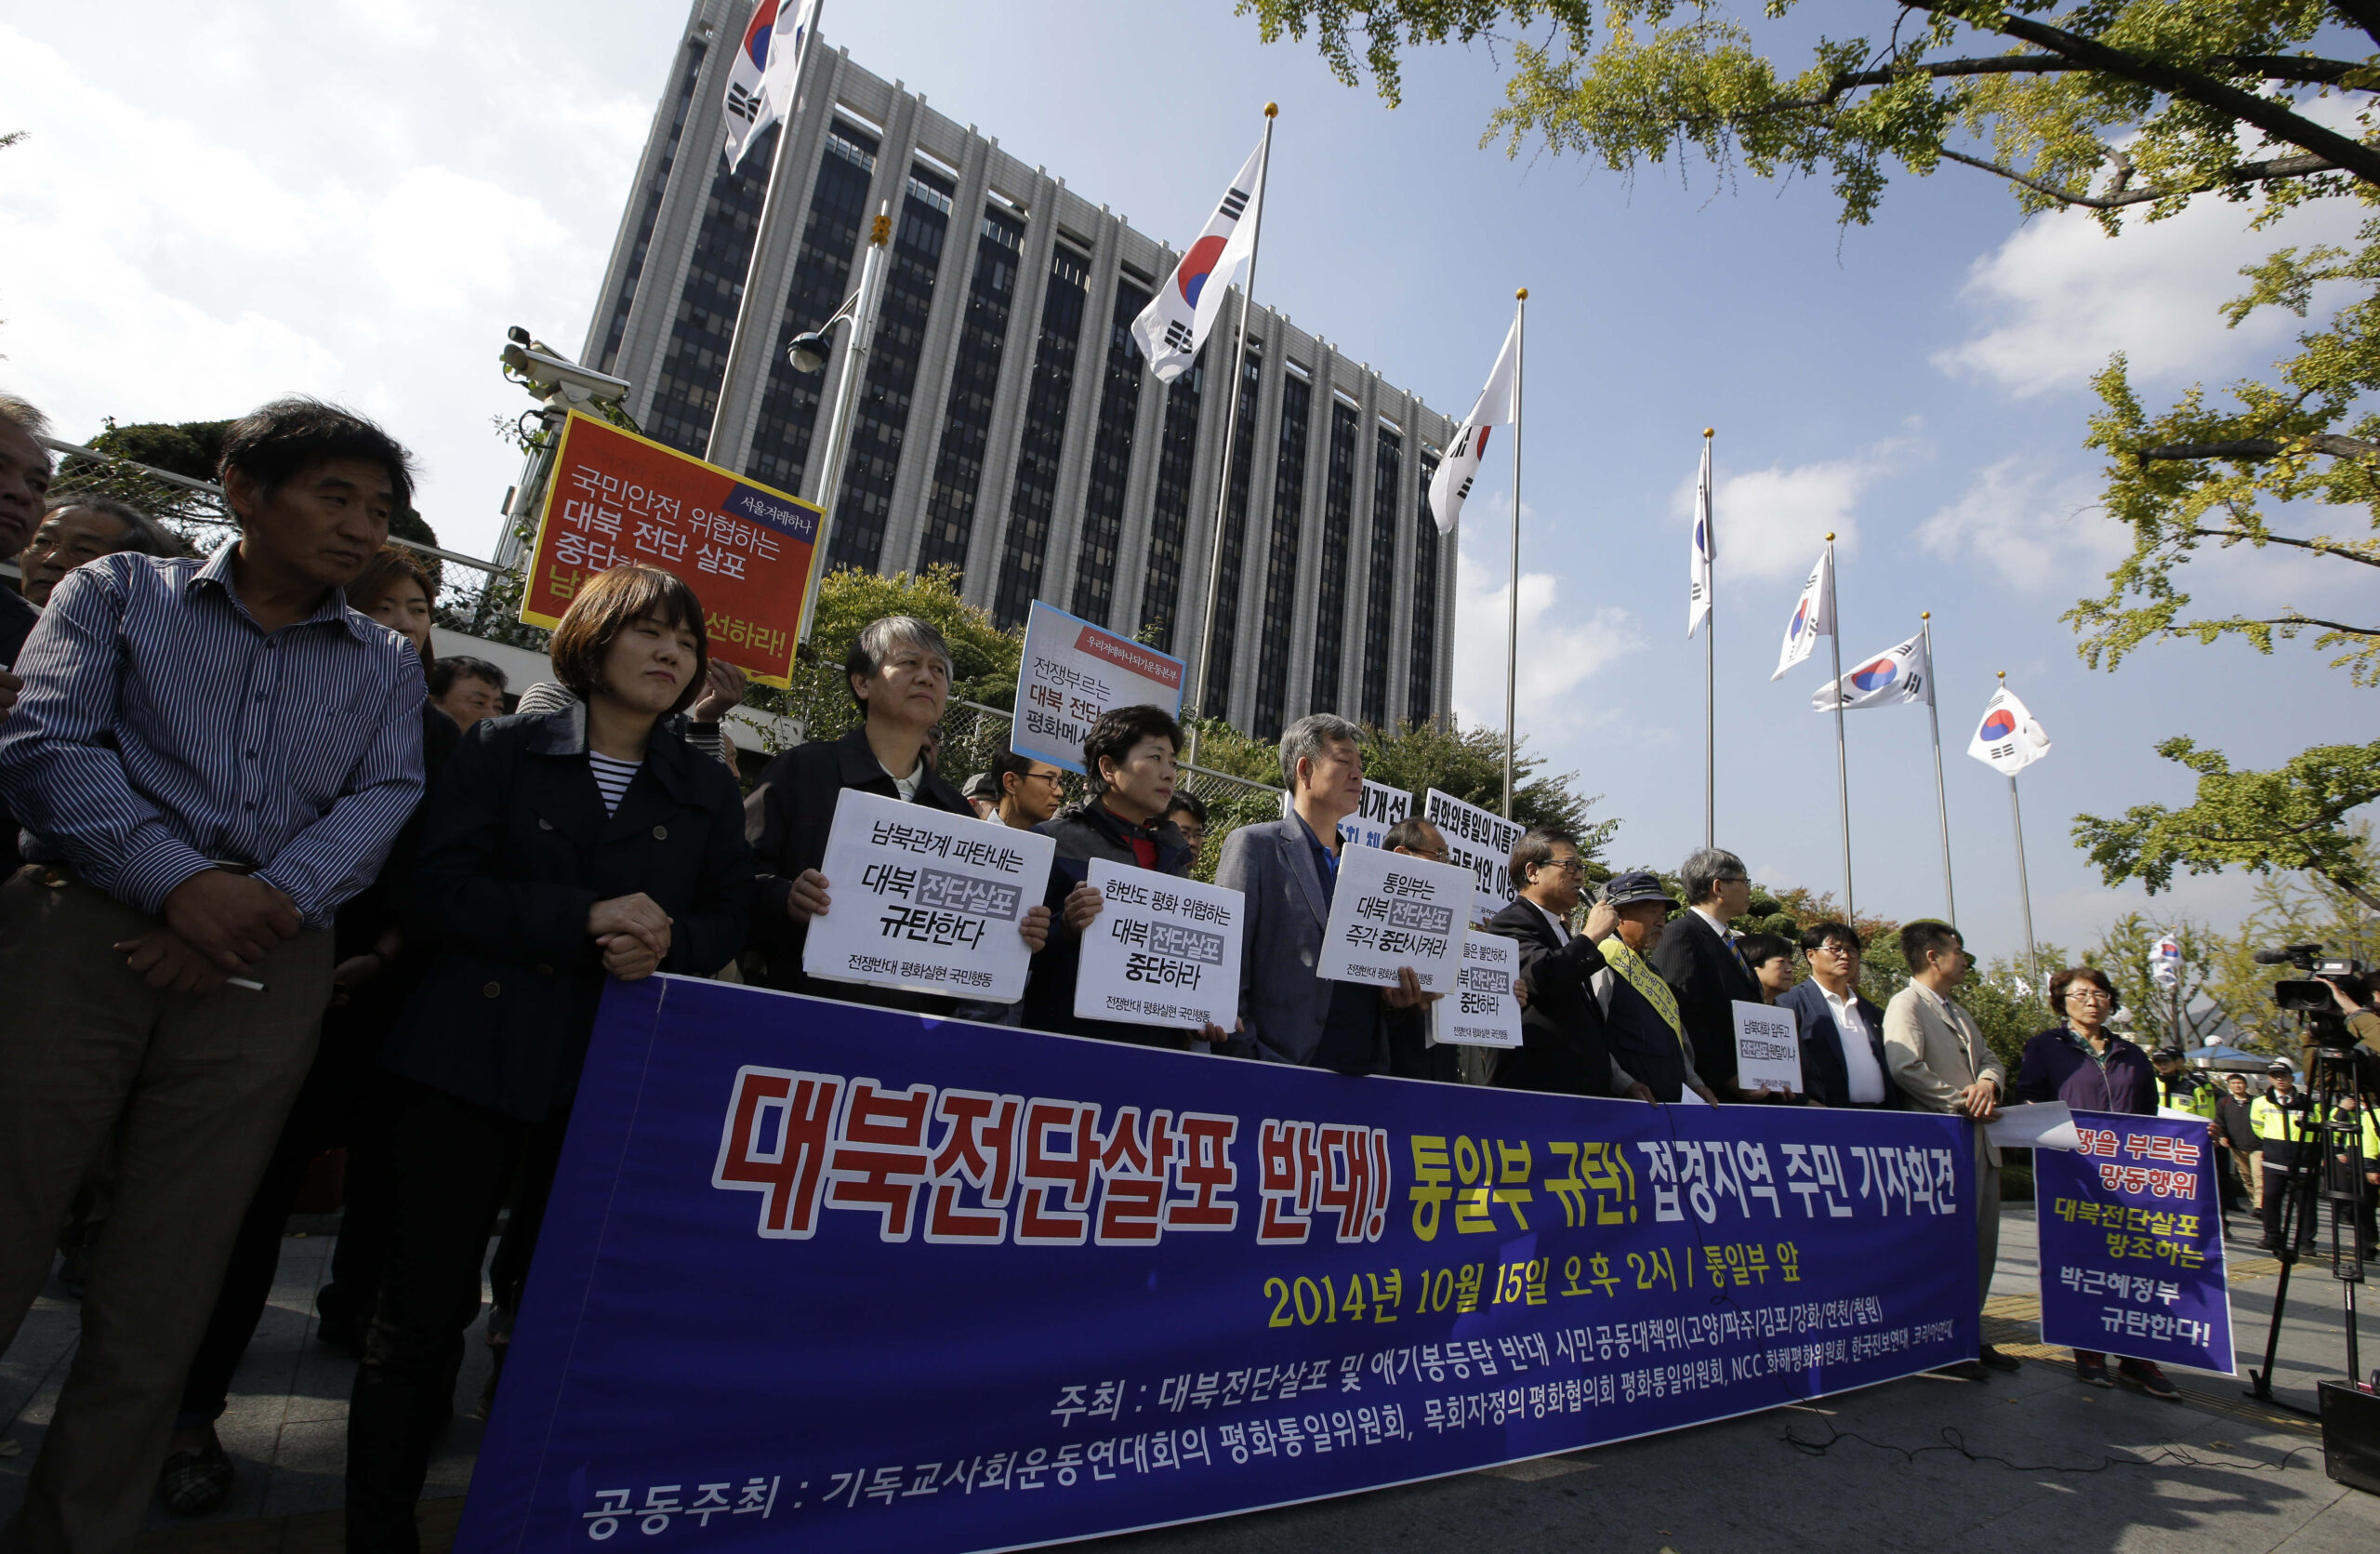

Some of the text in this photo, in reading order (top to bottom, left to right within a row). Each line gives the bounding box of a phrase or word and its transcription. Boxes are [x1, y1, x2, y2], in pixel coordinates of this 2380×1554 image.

[571, 464, 681, 526] 국민안전
[688, 508, 781, 562] 위협하는
[741, 496, 813, 536] 서울겨레하나
[563, 498, 747, 581] 대북 전단 살포
[702, 608, 787, 658] 선하라!
[1034, 657, 1111, 702] 전쟁부르는
[1029, 684, 1102, 724] 대북 전단
[870, 820, 1024, 873] 남북관계 파탄내는
[861, 864, 1016, 916] 대북 전단살포
[1105, 879, 1231, 926] 한반도 평화 위협하는
[1383, 872, 1435, 901] 통일부는
[880, 904, 985, 950] 규탄한다
[1356, 897, 1449, 931] 대북 전단살포
[1112, 918, 1221, 961] 대북 전단살포
[1346, 924, 1448, 960] 즉각 중단시켜라
[1479, 945, 1507, 963] 불안하다
[848, 954, 993, 988] 전쟁반대 평화실현 국민행동
[1126, 952, 1201, 990] 중단하라
[1347, 963, 1434, 986] 전쟁반대 평화실 행동
[1457, 968, 1507, 992] 북 전단살포
[1105, 995, 1210, 1023] 전쟁반대 평화실현 국민행동
[1461, 992, 1499, 1016] 중단하라
[1771, 1023, 1790, 1038] 앞두고
[711, 1065, 1956, 1246] 대북전단살포 반대! 통일부 규탄! 접경지역 주민 기자회견
[2124, 1133, 2201, 1166] 부르는
[2099, 1163, 2198, 1200] 망동행위
[2054, 1197, 2201, 1238] 대북전단살포
[2106, 1232, 2205, 1269] 방조하는
[1263, 1268, 1402, 1328] 2014년
[1416, 1263, 1485, 1314] 10월
[1491, 1257, 1549, 1306] 15일
[1560, 1252, 1621, 1298] 오후
[1627, 1247, 1677, 1293] 2시
[1703, 1243, 1770, 1289] 통일부
[1777, 1241, 1801, 1282] 앞
[2060, 1267, 2180, 1306] 박근혜정부
[2100, 1306, 2211, 1348] 규탄한다!
[1051, 1379, 1126, 1428] 주최
[1157, 1359, 1331, 1413] 대북전단살포
[1340, 1352, 1365, 1393] 및
[1370, 1338, 1499, 1385] 애기봉등탑
[1498, 1332, 1550, 1371] 반대
[582, 1475, 781, 1541] 공동주최
[822, 1426, 1211, 1508] 기독교사회운동연대회의
[1219, 1403, 1413, 1464] 평화통일위원회,
[1620, 1358, 1728, 1403] 평화통일위원회,
[1731, 1354, 1763, 1381] NCC
